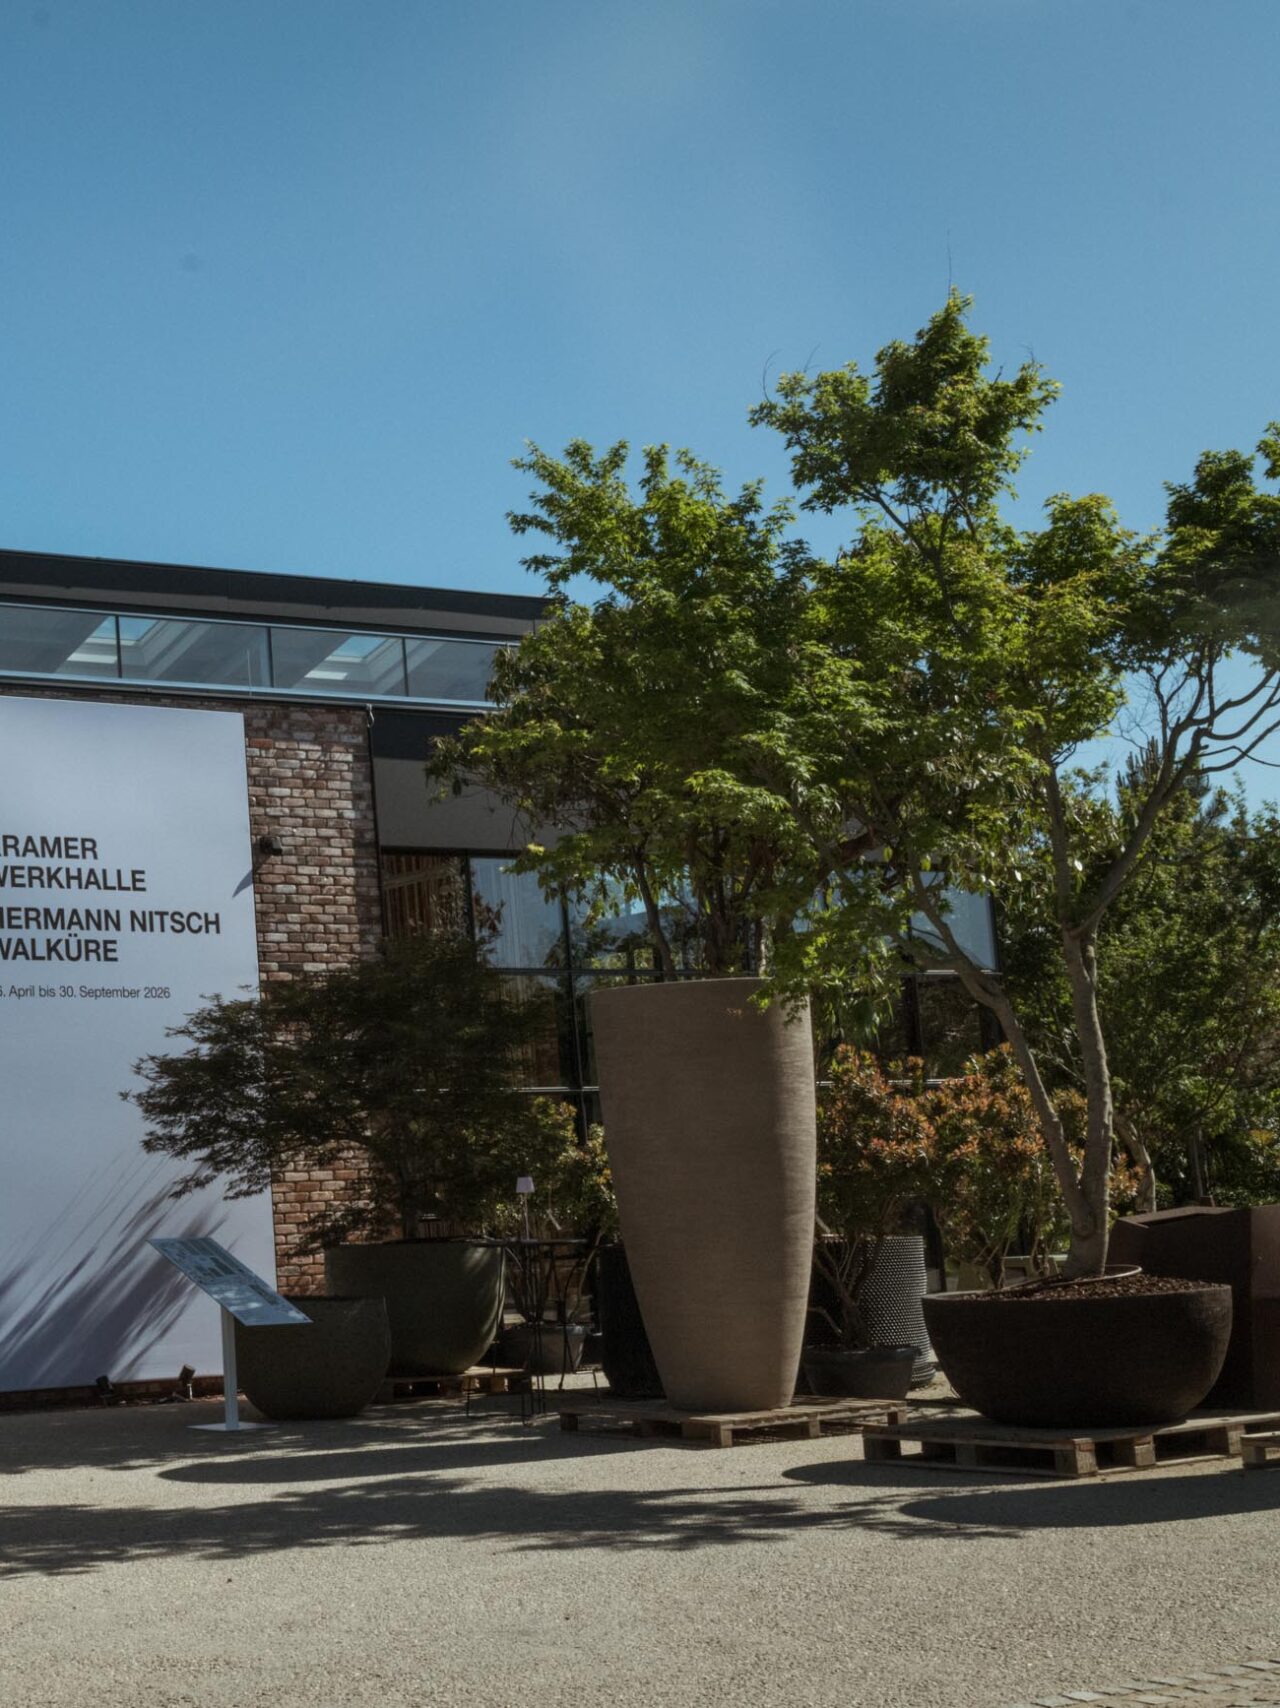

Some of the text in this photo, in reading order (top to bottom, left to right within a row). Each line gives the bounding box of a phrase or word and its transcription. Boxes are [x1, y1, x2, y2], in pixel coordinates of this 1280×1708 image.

[130, 909, 221, 934] NITSCH
[9, 985, 35, 1000] April
[38, 986, 57, 998] bis
[59, 986, 77, 998] 30.
[79, 986, 141, 1000] September
[143, 986, 171, 999] 2026
